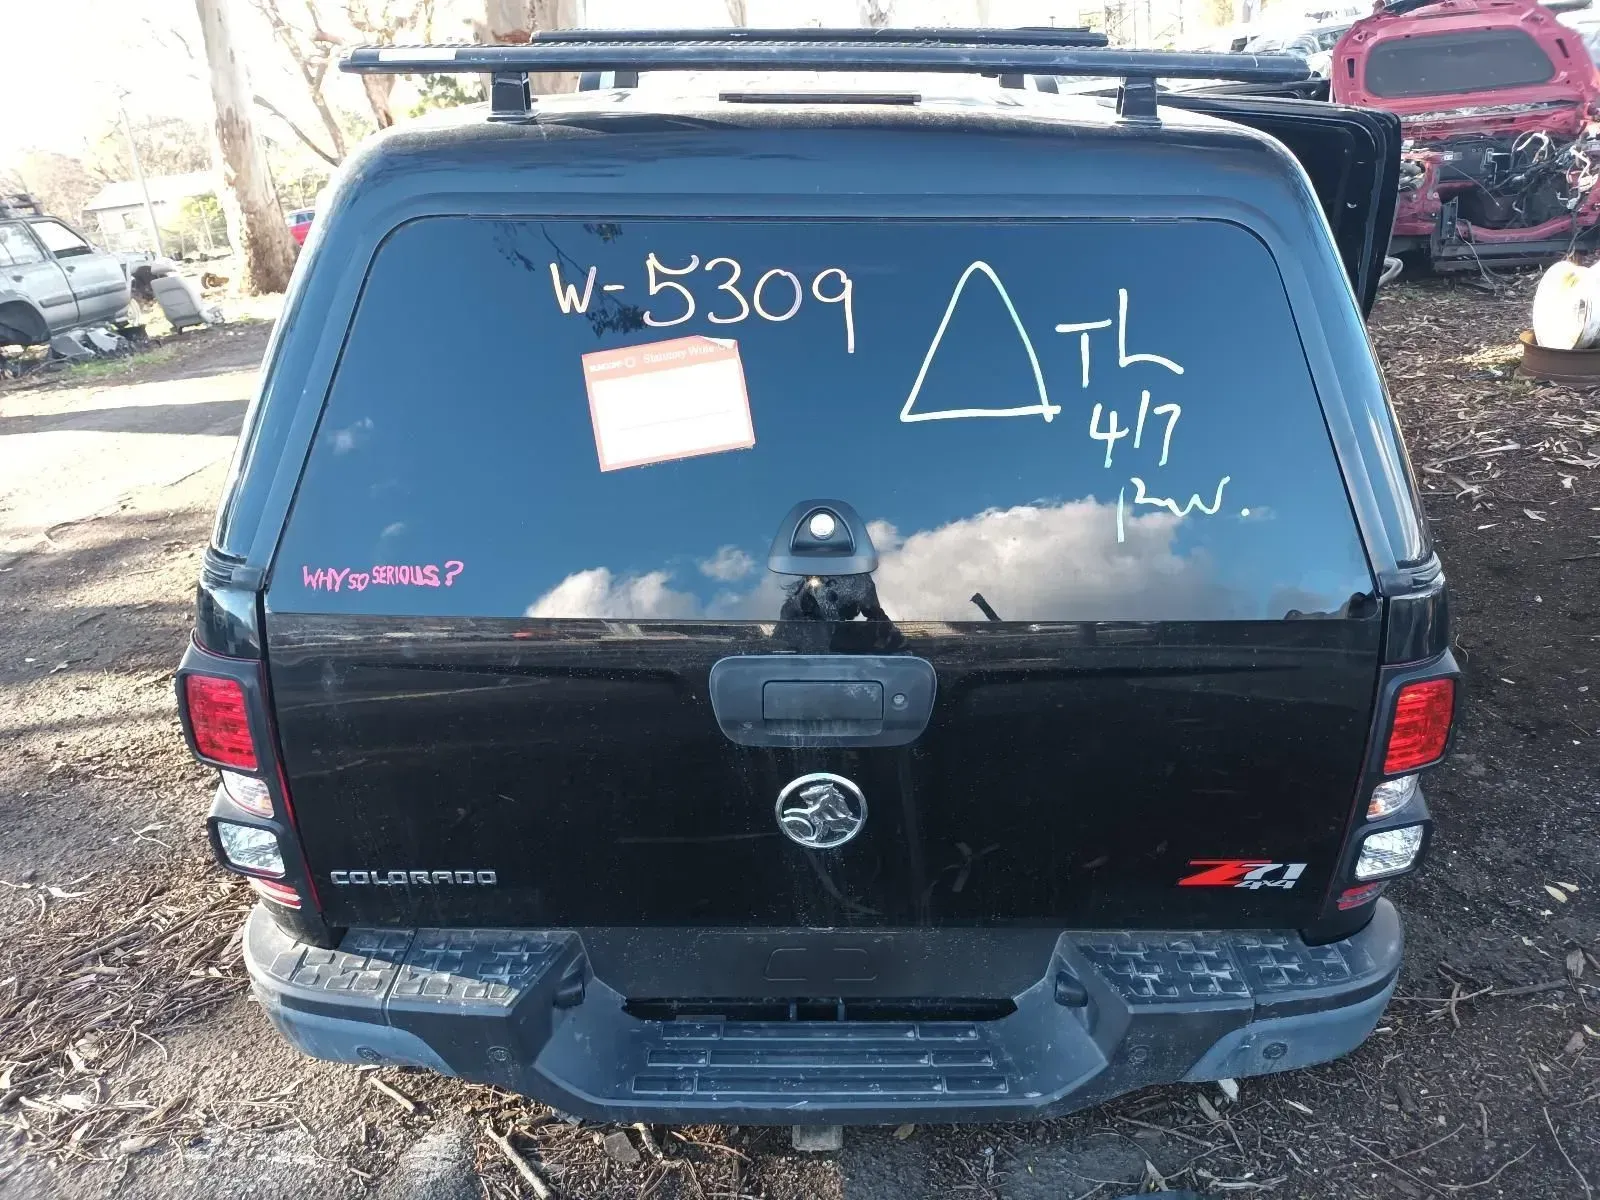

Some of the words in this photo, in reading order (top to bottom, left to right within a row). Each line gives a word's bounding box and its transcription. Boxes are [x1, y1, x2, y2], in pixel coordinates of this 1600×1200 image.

[1089, 390, 1181, 468] 4/7
[302, 565, 350, 592] WHY
[347, 573, 370, 592] SO
[330, 871, 497, 885] COLORADO
[1178, 859, 1308, 887] Z71
